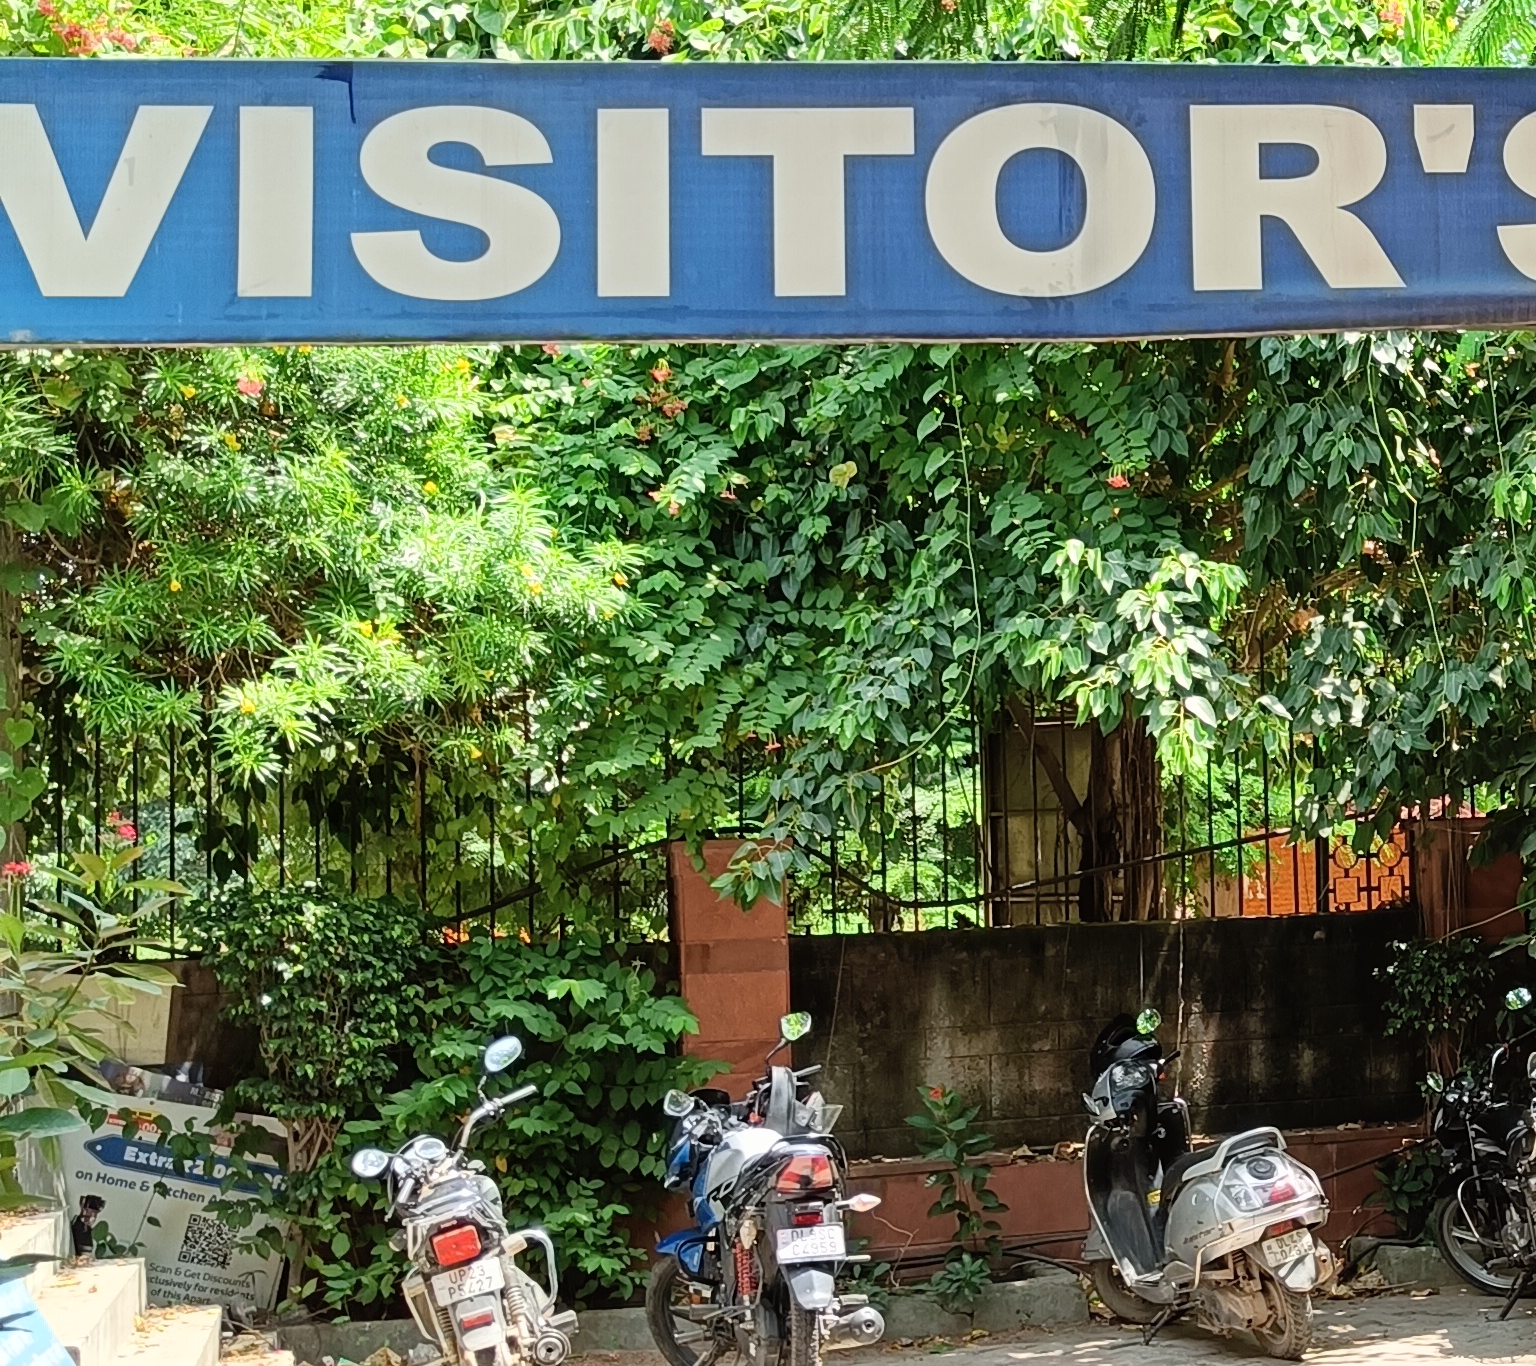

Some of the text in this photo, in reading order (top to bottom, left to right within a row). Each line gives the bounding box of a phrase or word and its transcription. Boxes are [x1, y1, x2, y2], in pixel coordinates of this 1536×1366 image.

[75, 1169, 92, 1181] on
[96, 1172, 136, 1189] Home
[139, 1180, 151, 1192] &
[148, 1262, 250, 1288] Scan & Get Discounts
[148, 1275, 192, 1292] clusively
[194, 1283, 208, 1293] for
[150, 1288, 162, 1297] of
[163, 1289, 181, 1300] this
